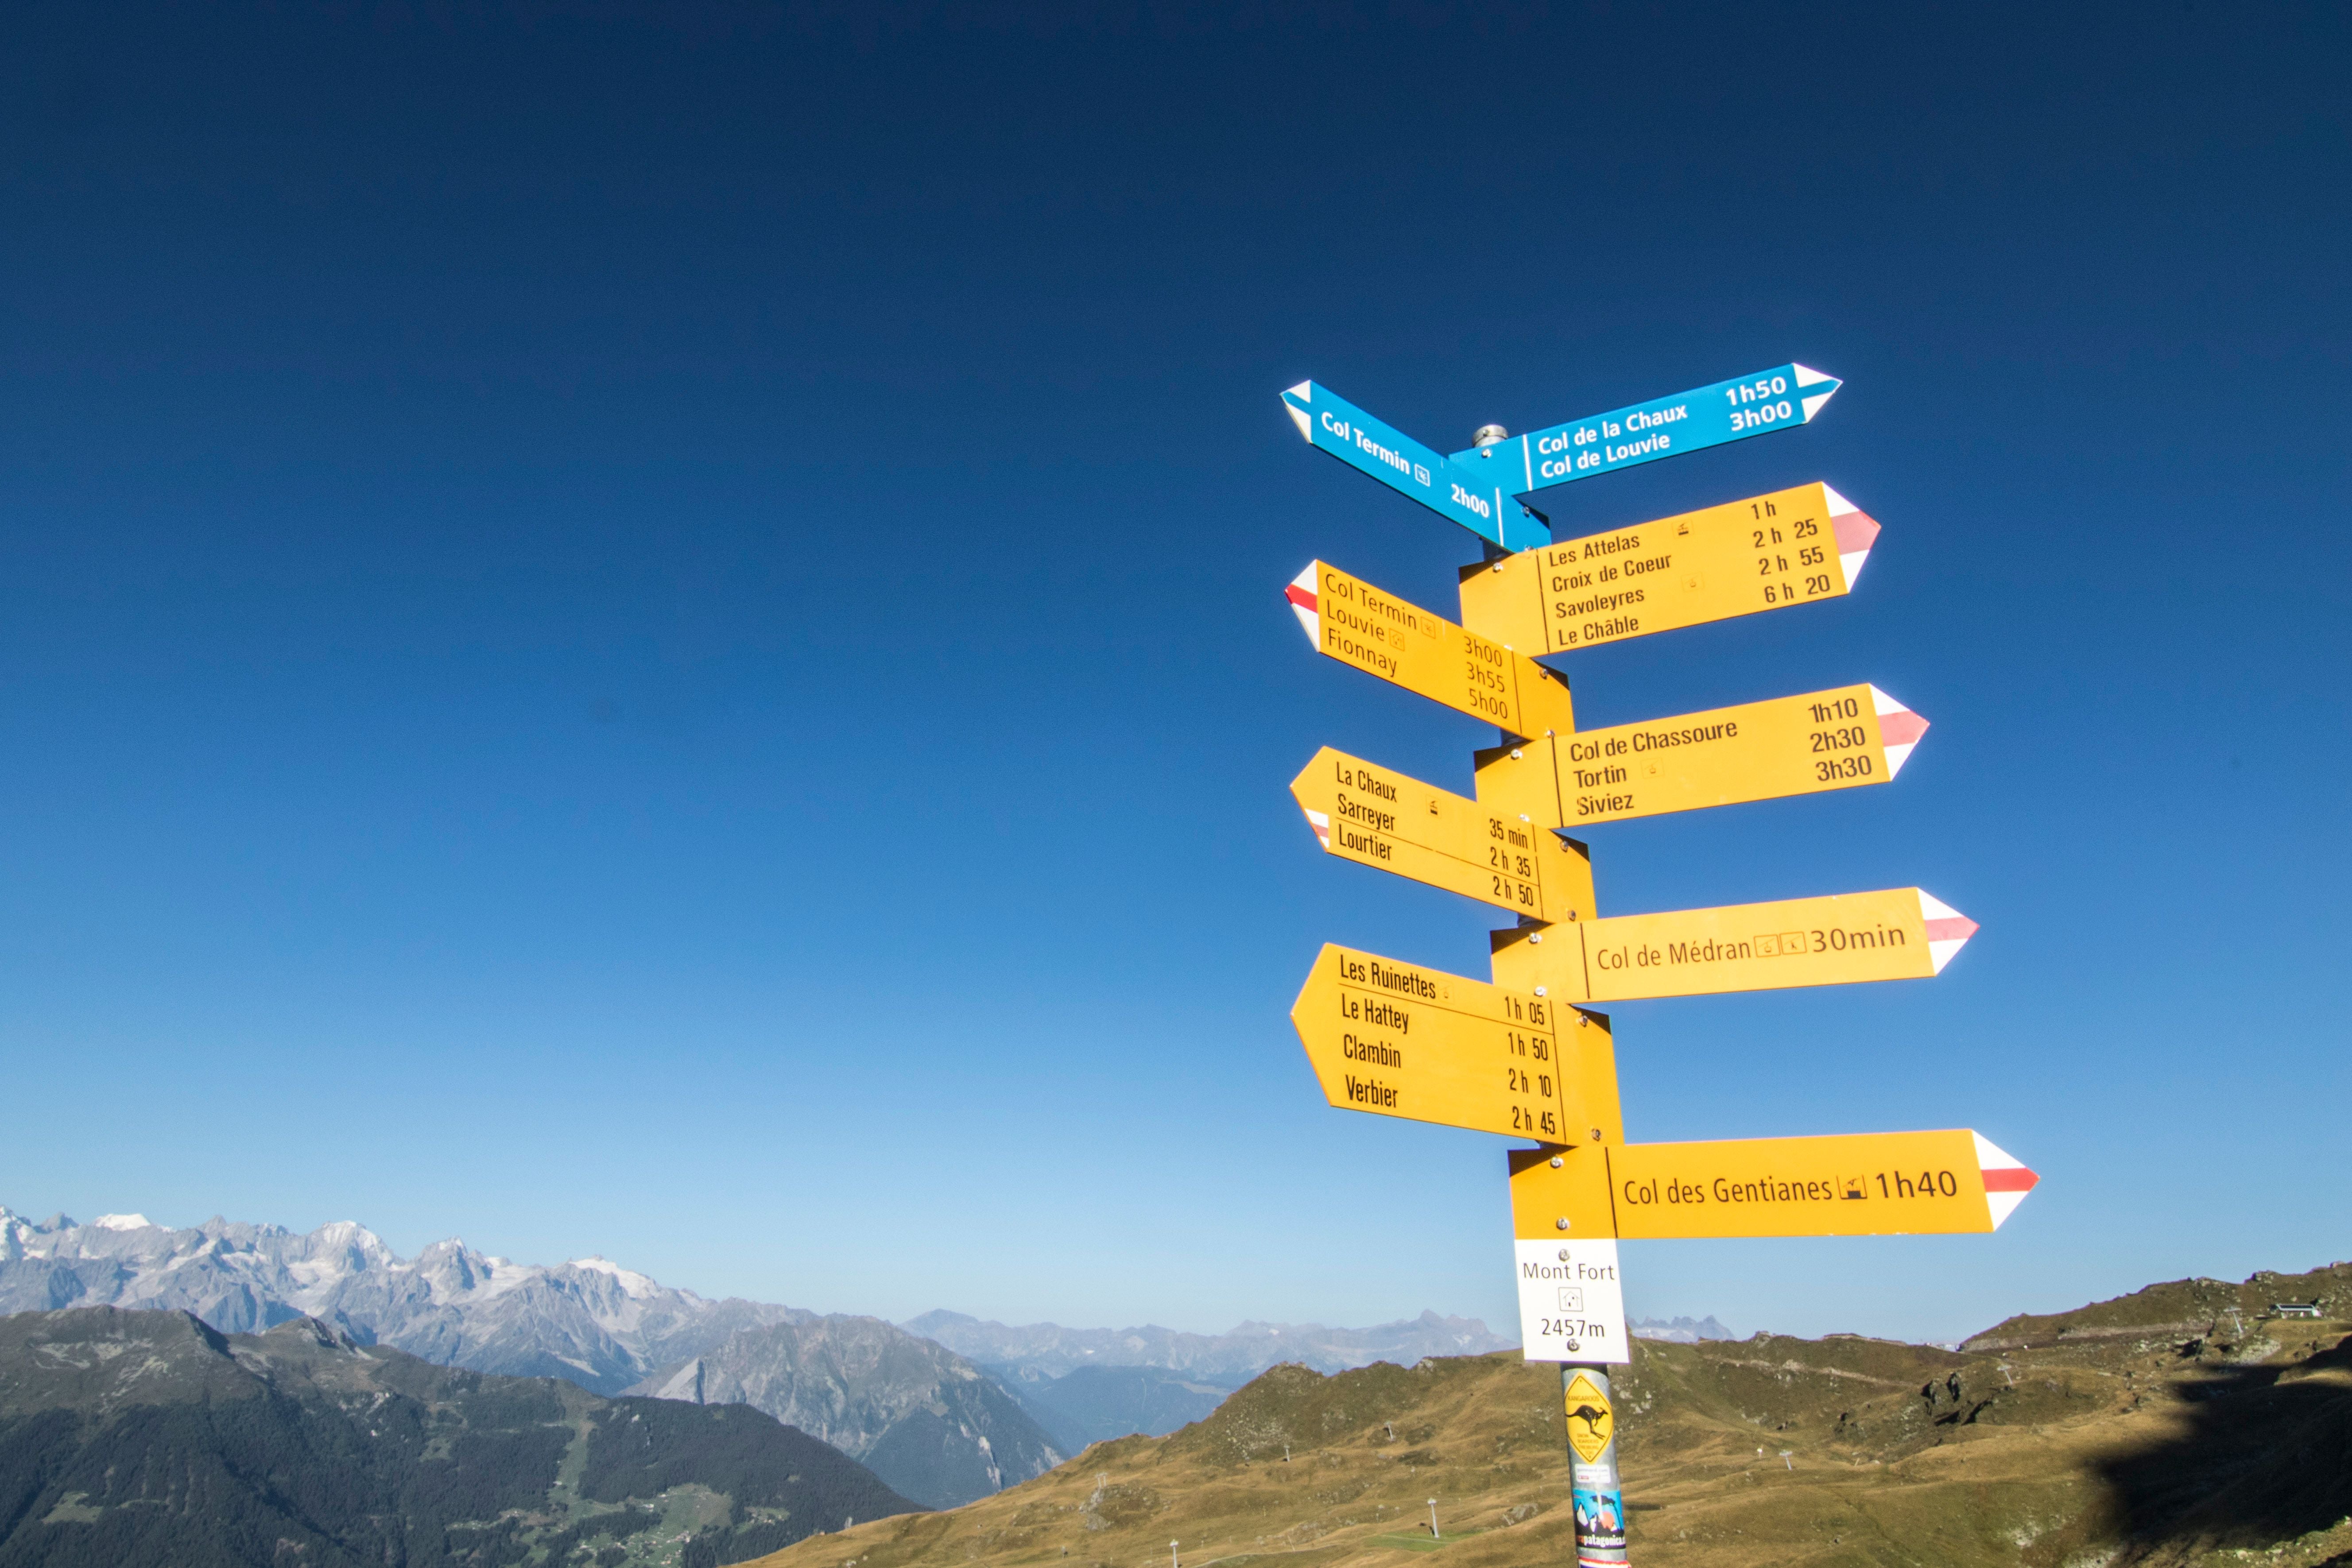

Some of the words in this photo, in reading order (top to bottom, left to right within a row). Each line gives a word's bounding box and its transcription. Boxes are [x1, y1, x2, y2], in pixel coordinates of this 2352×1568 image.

[1538, 432, 1568, 454] Col
[1574, 426, 1597, 446] de
[1603, 421, 1620, 438] la
[1626, 404, 1687, 432] Chaux
[1726, 376, 1787, 406] 1h50
[1541, 455, 1571, 479] Col
[1577, 449, 1600, 470] de
[1606, 434, 1670, 463] Louvie
[1729, 400, 1792, 432] 3h00
[1321, 412, 1349, 441] Col
[1354, 428, 1410, 475] Termin
[1451, 484, 1489, 519] 2h00
[1549, 550, 1577, 567] Les
[1584, 536, 1640, 559] Attelas
[1552, 572, 1593, 592] Croix
[1600, 565, 1618, 582] de
[1624, 555, 1672, 576] Coeur
[1794, 518, 1818, 539] 25
[1556, 589, 1645, 618] Savoleyres
[1799, 546, 1824, 566] 55
[1326, 574, 1353, 601] Col
[1359, 588, 1417, 630] Termin
[1465, 636, 1502, 667] 3h00
[1327, 599, 1385, 641] Louvie
[1467, 662, 1505, 693] 3h55
[1558, 630, 1577, 646] Le
[1584, 616, 1639, 640] Châble
[1806, 574, 1830, 595] 20
[1328, 627, 1397, 678] Fionnay
[1469, 688, 1507, 720] 5h00
[1570, 740, 1600, 762] Col
[1605, 738, 1627, 757] de
[1633, 722, 1738, 752] Chassoure
[1808, 698, 1859, 723] 1h10
[1573, 765, 1627, 789] Tortin
[1810, 726, 1866, 753] 2h30
[1337, 761, 1352, 786] La
[1358, 770, 1397, 803] Chaux
[1490, 818, 1503, 840] 35
[1509, 829, 1528, 849] min
[1577, 794, 1634, 816] Siviez
[1815, 755, 1872, 782] 3h30
[1338, 793, 1395, 832] Sarreyer
[1517, 855, 1531, 877] 35
[1339, 824, 1392, 861] Lourtier
[1519, 884, 1534, 906] 50
[1598, 946, 1629, 970] Col
[1638, 944, 1661, 967] de
[1669, 938, 1751, 964] Médran
[1811, 923, 1906, 953] 30min
[1340, 954, 1365, 982] Les
[1372, 962, 1436, 999] Ruinettes
[1529, 1002, 1545, 1026] 05
[1342, 993, 1359, 1019] Le
[1365, 998, 1409, 1034] Hattey
[1533, 1037, 1548, 1061] 50
[1344, 1034, 1401, 1069] Clambin
[1538, 1074, 1551, 1098] 10
[1345, 1074, 1398, 1108] Verbier
[1541, 1111, 1555, 1135] 45
[1624, 1178, 1658, 1205] Col
[1668, 1178, 1705, 1204] des
[1713, 1175, 1833, 1202] Gentianes
[1875, 1170, 1957, 1199] 1h40
[1523, 1262, 1571, 1279] Mont
[1578, 1263, 1614, 1280] Fort
[1541, 1318, 1604, 1337] 2457m
